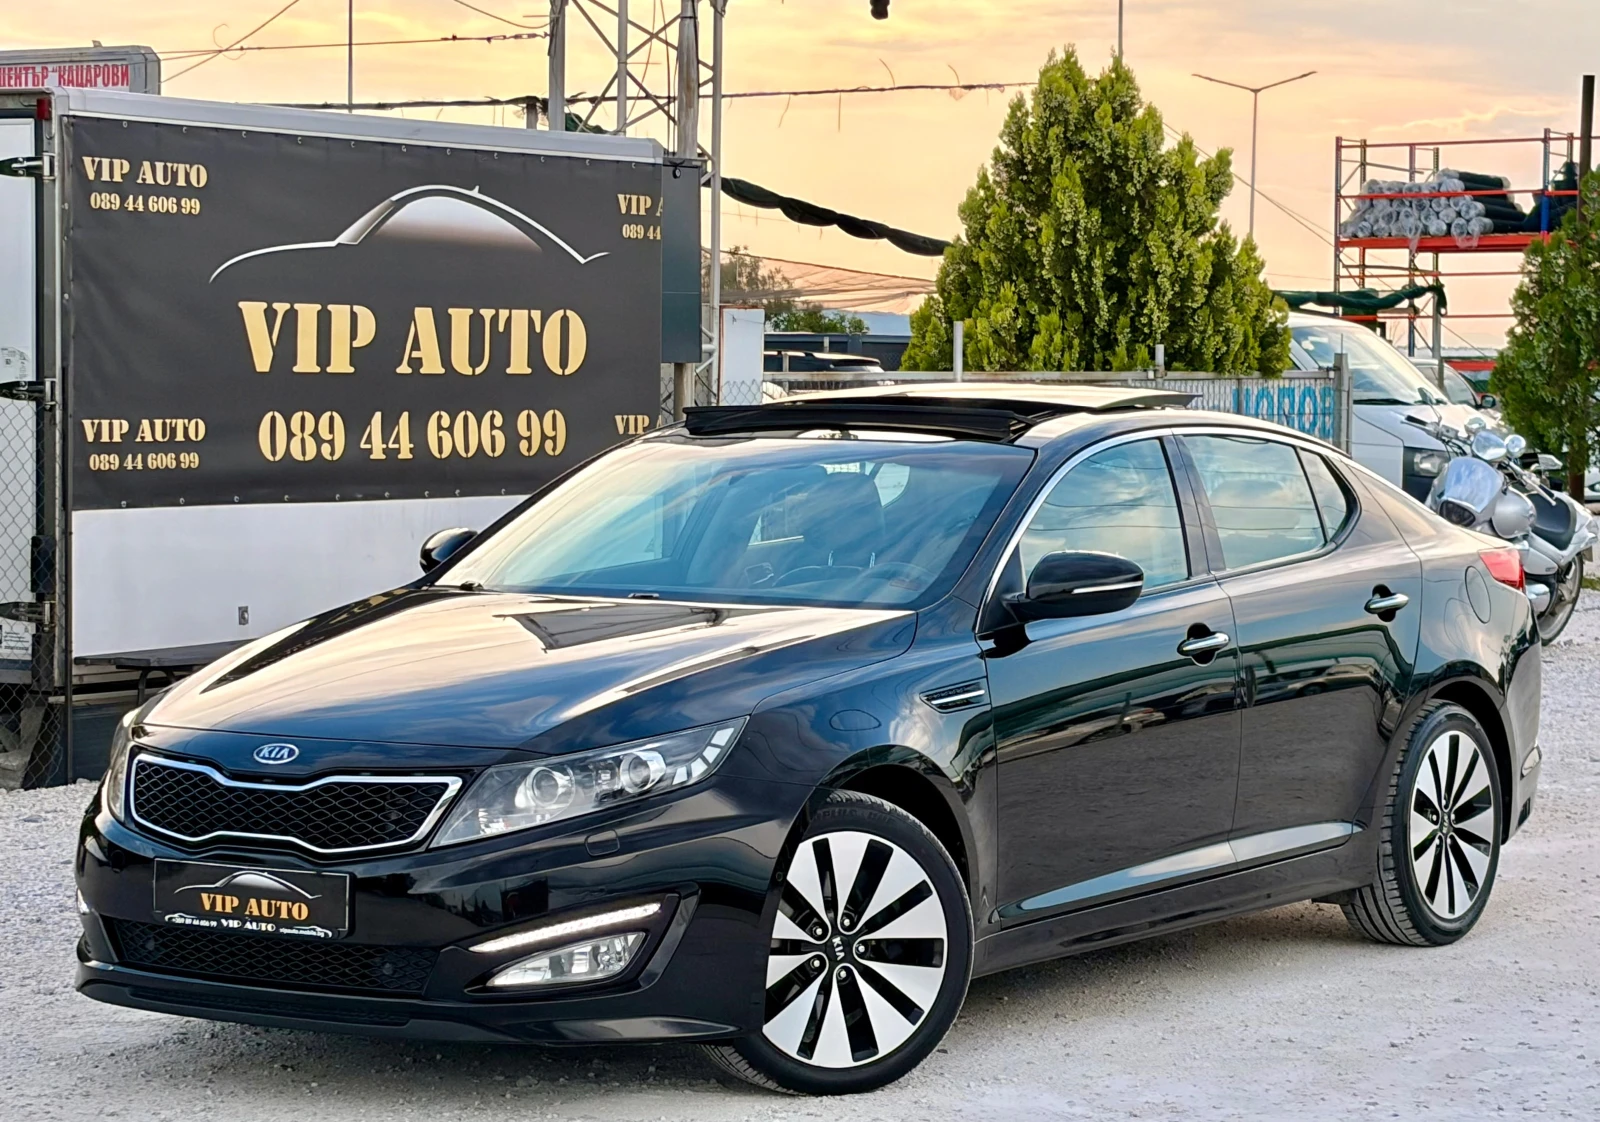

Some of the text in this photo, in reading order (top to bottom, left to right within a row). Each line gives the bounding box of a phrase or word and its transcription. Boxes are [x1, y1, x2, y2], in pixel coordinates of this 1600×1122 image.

[82, 156, 208, 187] VIP AUTO
[90, 192, 200, 215] 089 44 606 99
[617, 194, 652, 216] VIP
[622, 223, 661, 240] 089 44
[238, 301, 587, 375] VIP AUTO
[81, 418, 206, 443] VIP AUTO
[258, 409, 567, 462] 089 44 606 99
[615, 415, 650, 434] VIP
[89, 452, 200, 471] 089 44 606 99
[201, 892, 309, 920] VIP AUTO
[220, 918, 242, 928] VIP
[243, 921, 277, 932] AUTO
[832, 936, 846, 961] KIA
